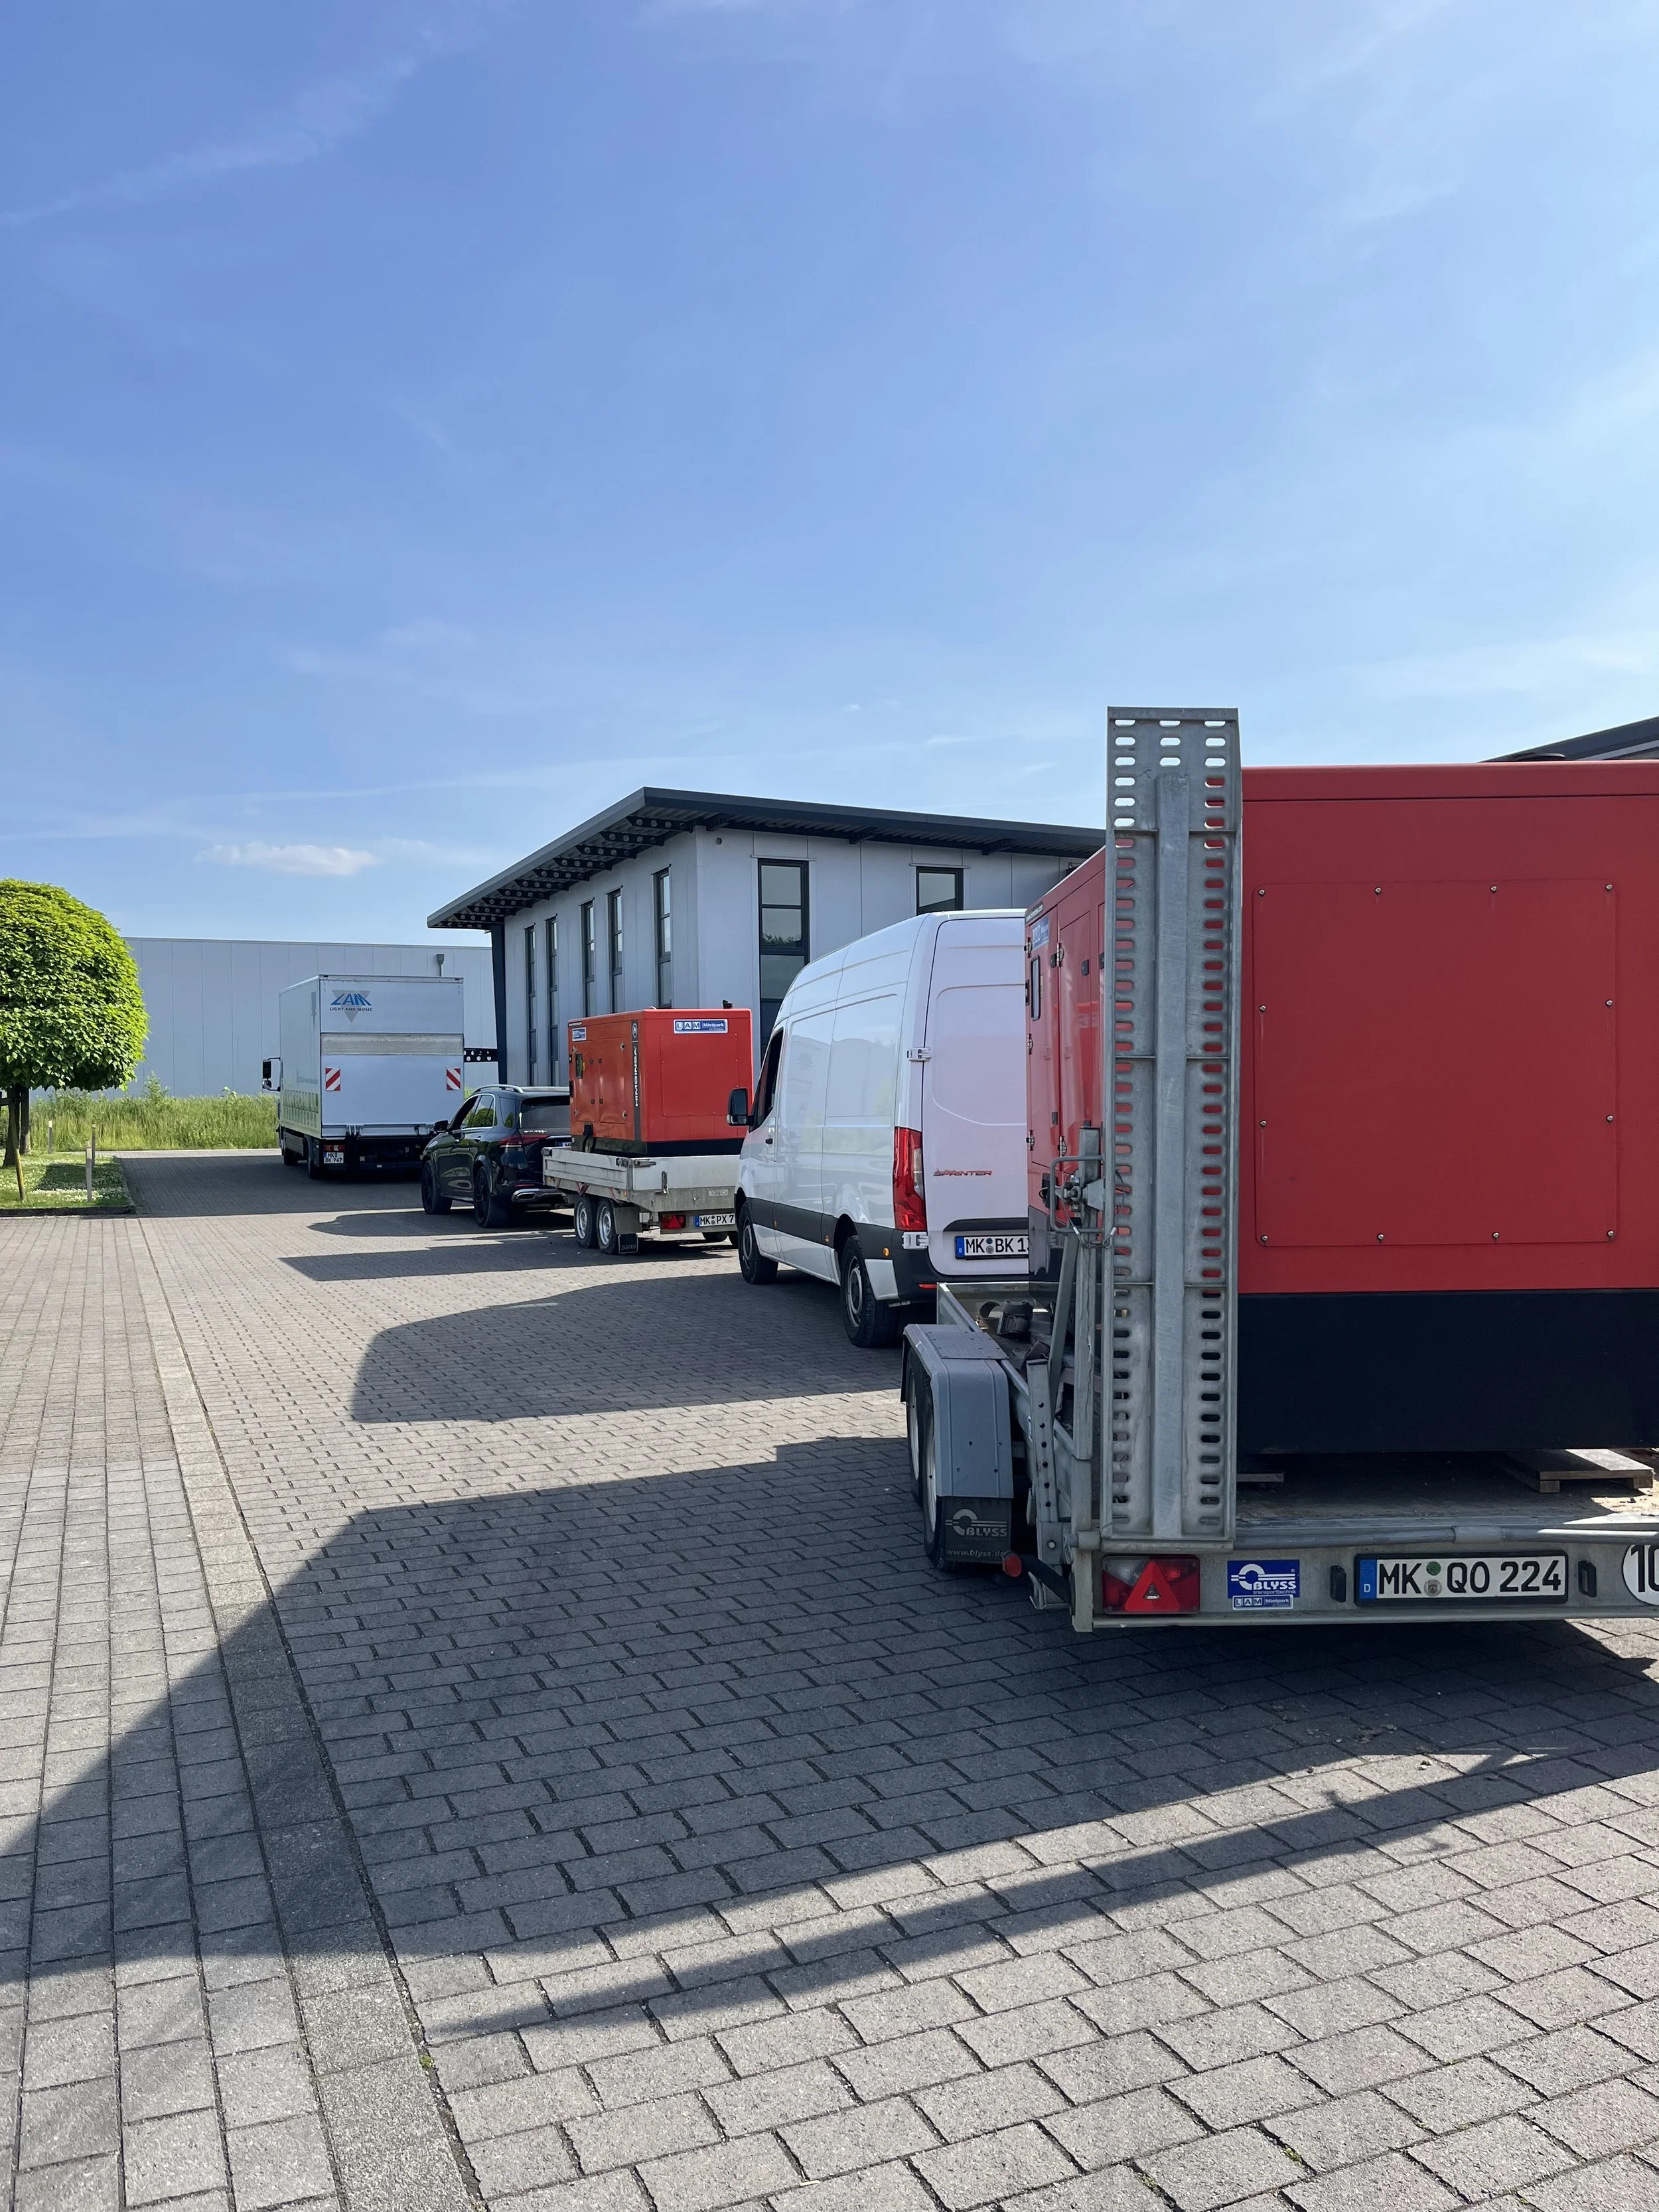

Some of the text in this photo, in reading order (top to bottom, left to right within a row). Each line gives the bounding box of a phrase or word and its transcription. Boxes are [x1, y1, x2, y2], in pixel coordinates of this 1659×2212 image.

[700, 1216, 711, 1225] MK
[716, 1215, 727, 1224] PX
[966, 1238, 985, 1253] MK
[995, 1238, 1014, 1252] BK
[1017, 1237, 1029, 1252] 1
[966, 1527, 1008, 1537] BLYSS
[1364, 1560, 1561, 1594] D MK QO 224
[1253, 1581, 1297, 1590] BLYSS
